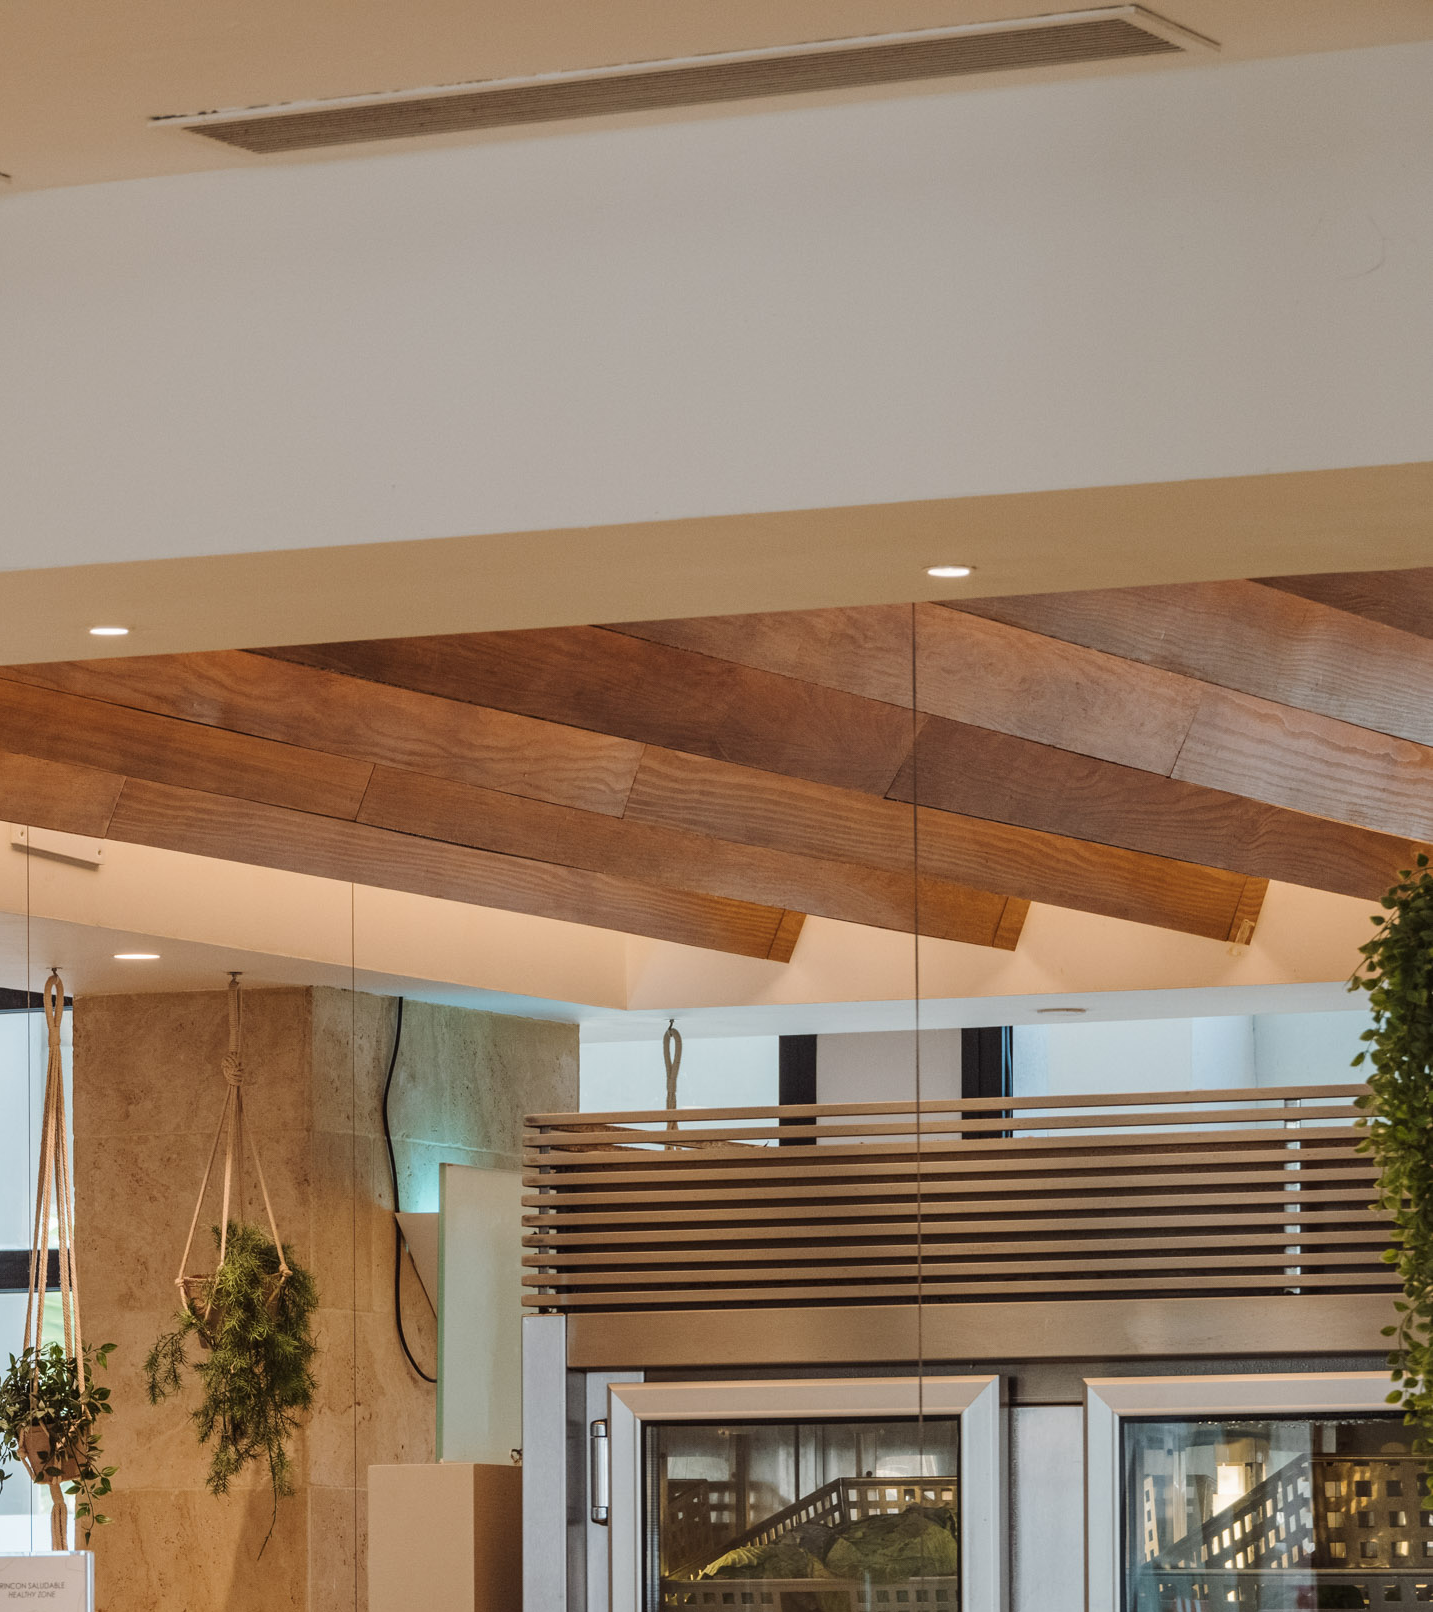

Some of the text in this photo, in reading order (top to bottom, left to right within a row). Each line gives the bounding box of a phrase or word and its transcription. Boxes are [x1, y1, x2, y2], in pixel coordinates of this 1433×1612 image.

[0, 1582, 64, 1590] RINCON SALUDABLE
[8, 1591, 36, 1599] HEALTHY
